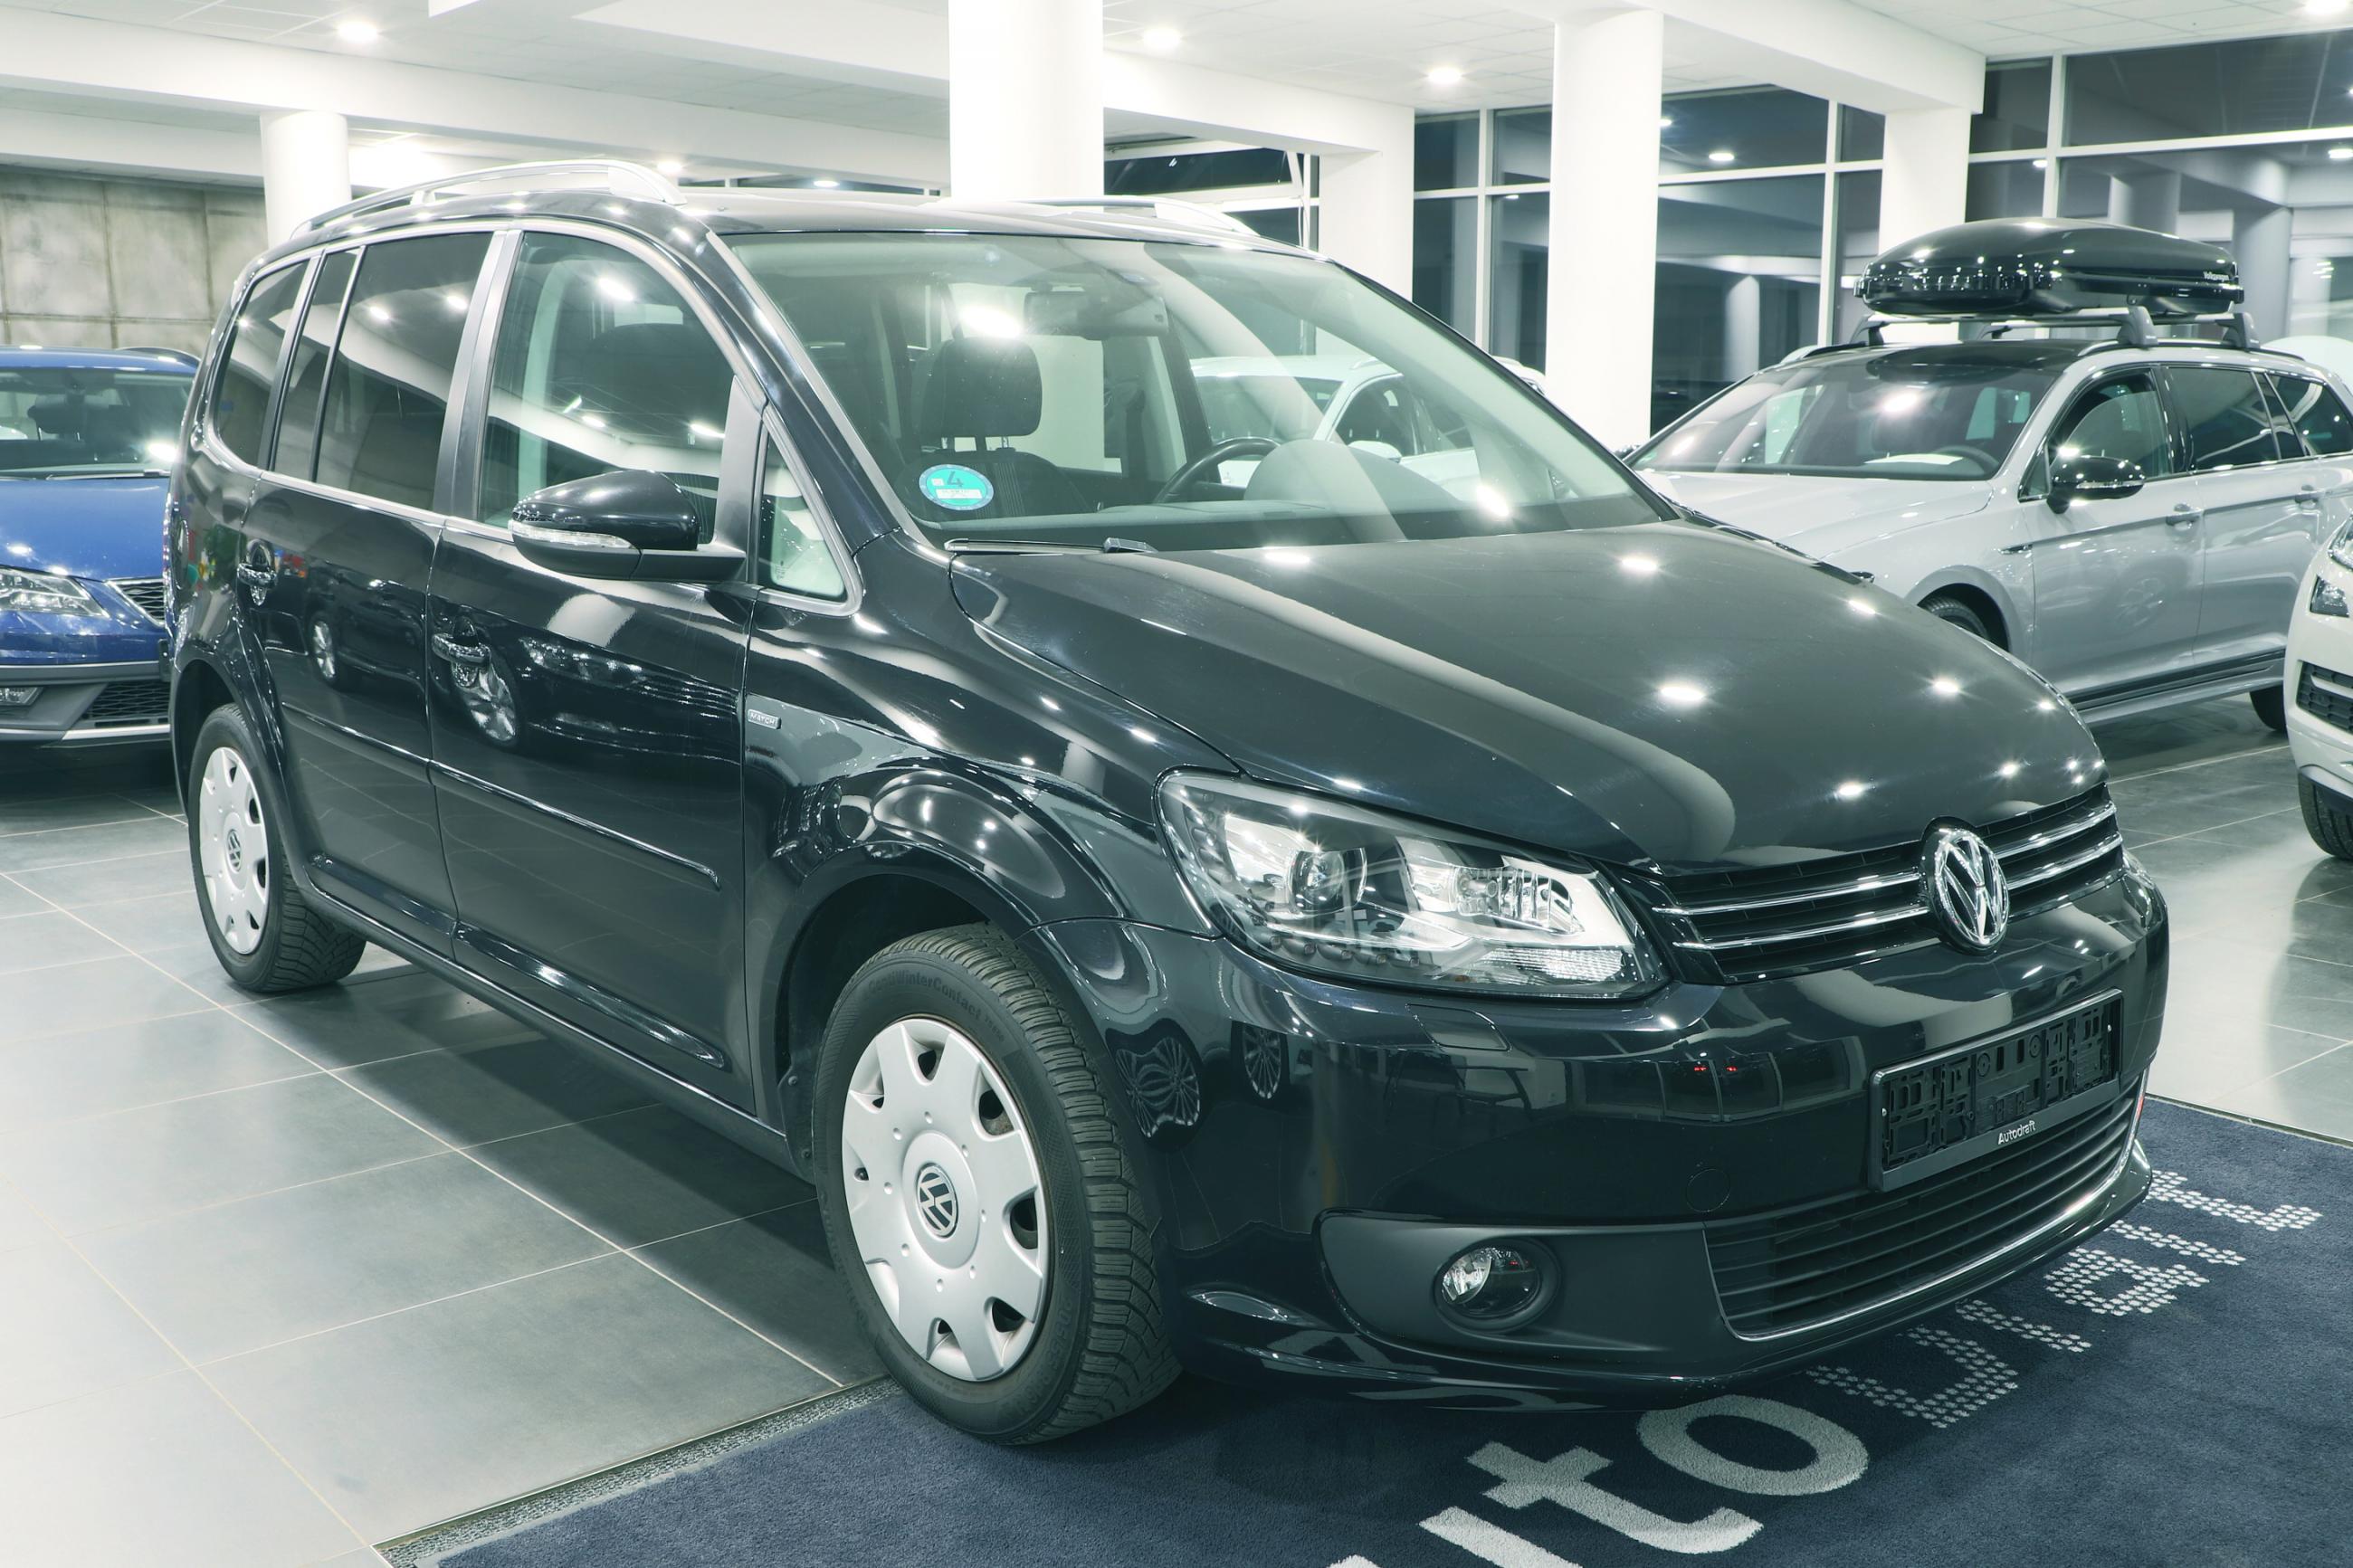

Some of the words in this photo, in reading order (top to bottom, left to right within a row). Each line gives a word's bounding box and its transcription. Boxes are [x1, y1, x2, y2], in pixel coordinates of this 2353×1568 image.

[947, 471, 963, 487] 4
[750, 711, 776, 725] MATCH
[1997, 1119, 2036, 1145] Autodraft
